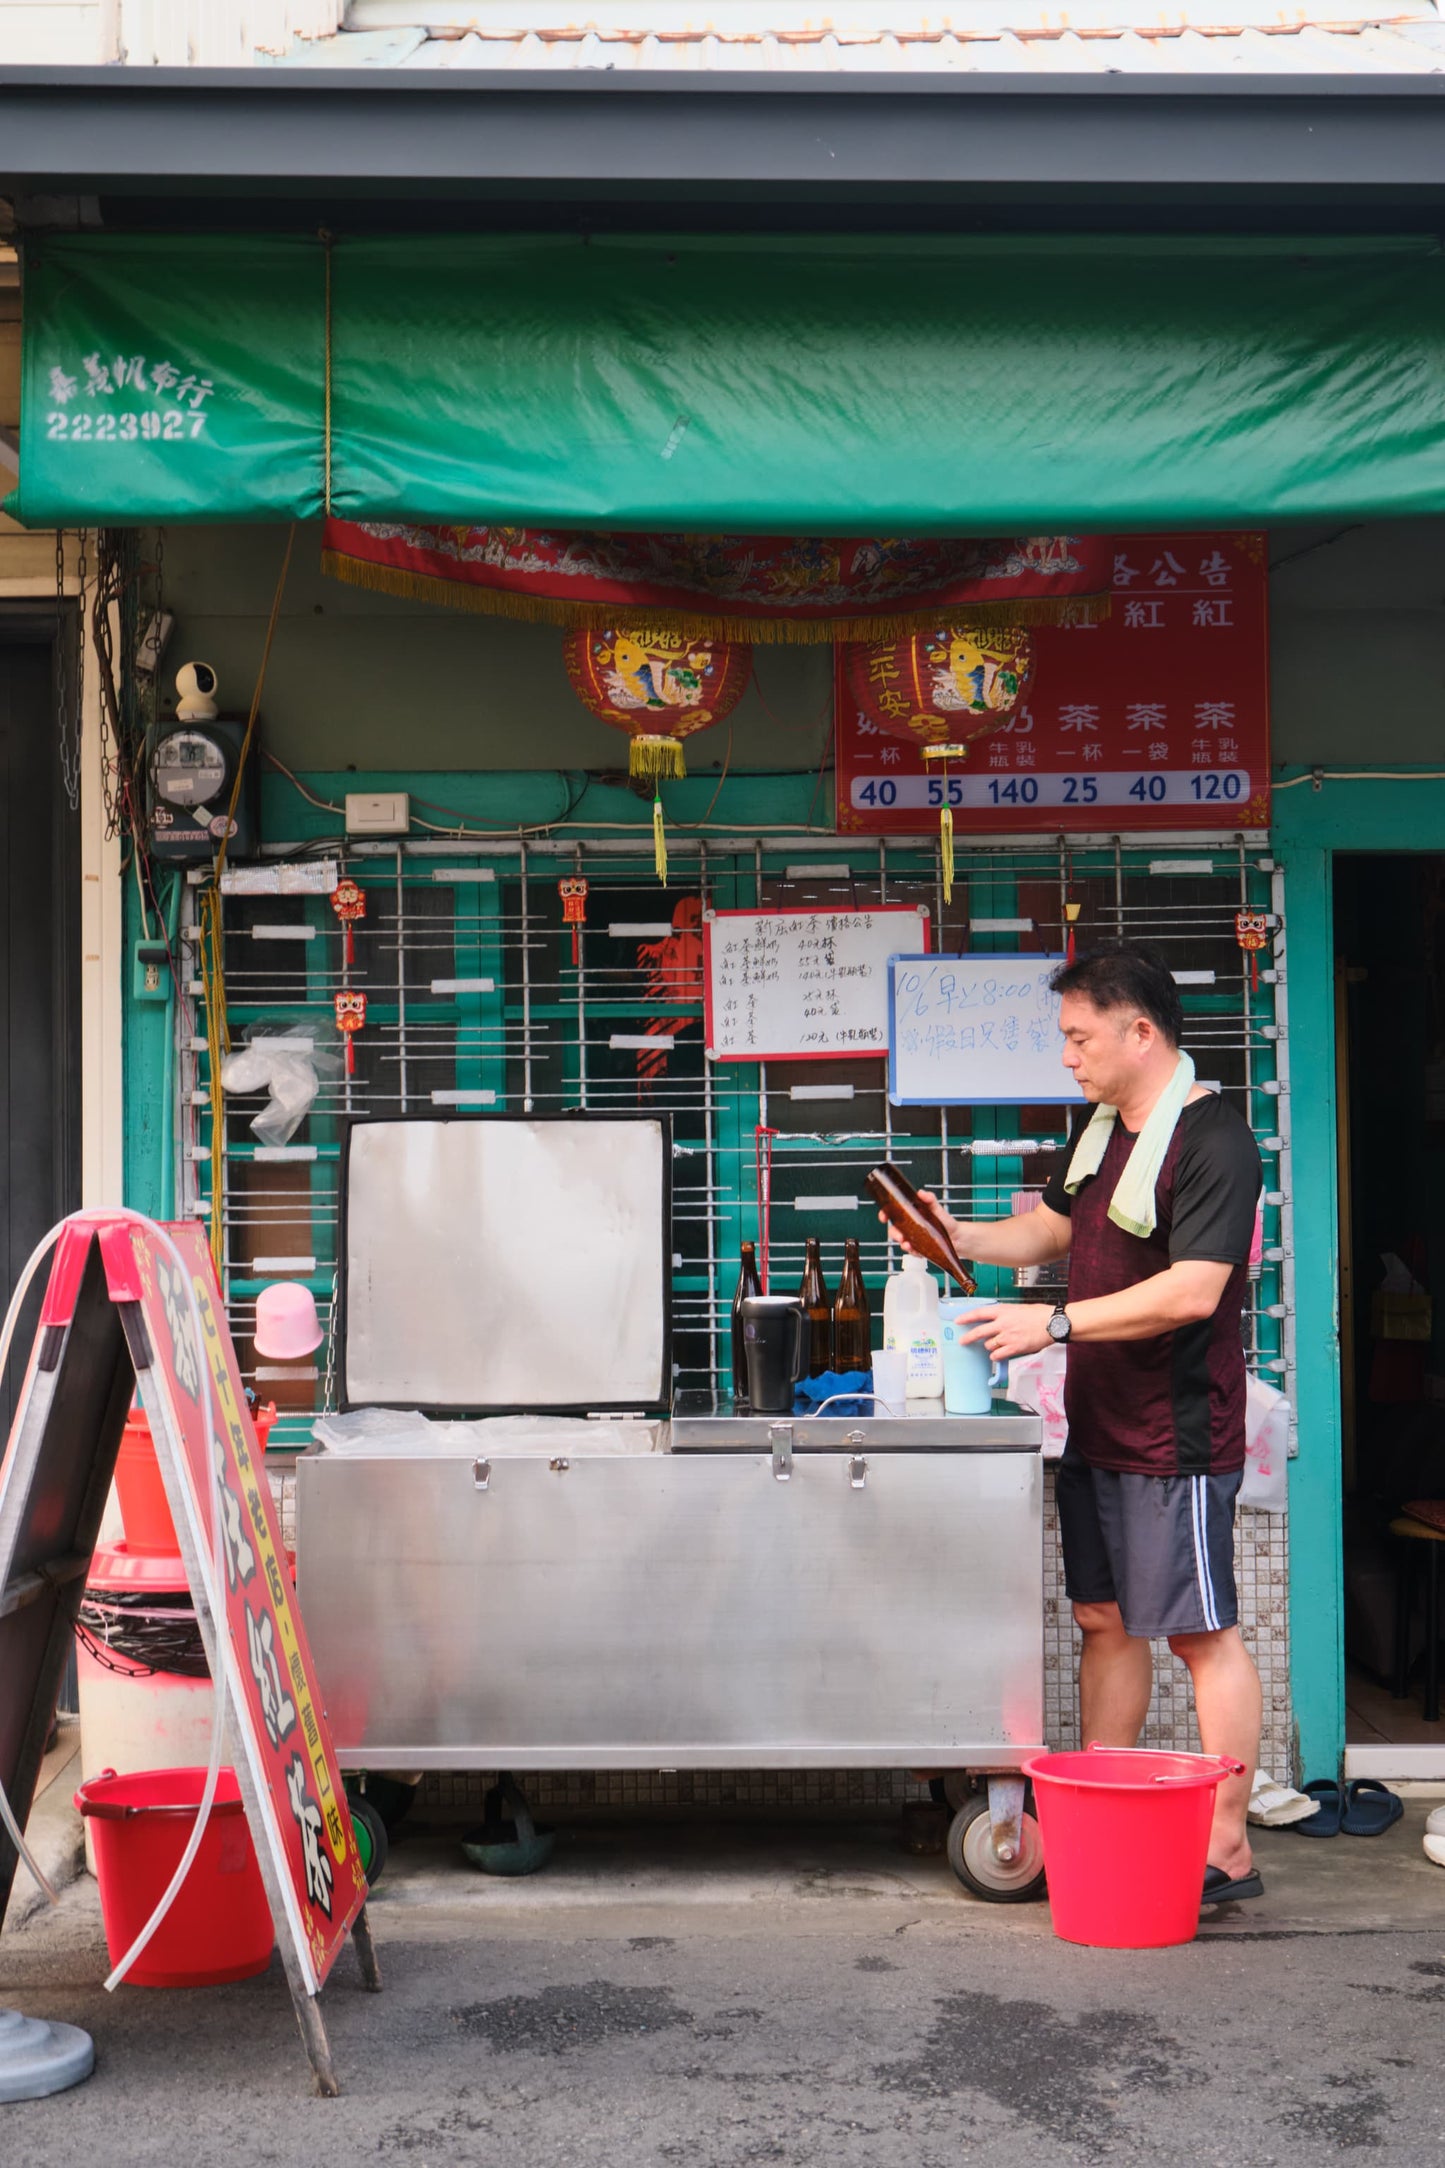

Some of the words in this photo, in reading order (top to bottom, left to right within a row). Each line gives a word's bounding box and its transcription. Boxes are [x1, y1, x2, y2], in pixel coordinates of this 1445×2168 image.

[47, 410, 208, 441] 2223927
[1124, 600, 1166, 628] 紅
[1192, 599, 1234, 628] 紅
[1058, 704, 1100, 732] 茶
[1125, 703, 1167, 731] 茶
[1193, 701, 1236, 730] 茶
[854, 747, 902, 766] 一杯
[1056, 744, 1104, 763] 一杯
[1122, 741, 1170, 762] 一袋
[859, 780, 897, 806] 40
[927, 779, 964, 805] 55
[988, 778, 1039, 804] 140
[1062, 777, 1099, 803] 25
[1129, 776, 1167, 801] 40
[1190, 774, 1241, 800] 120
